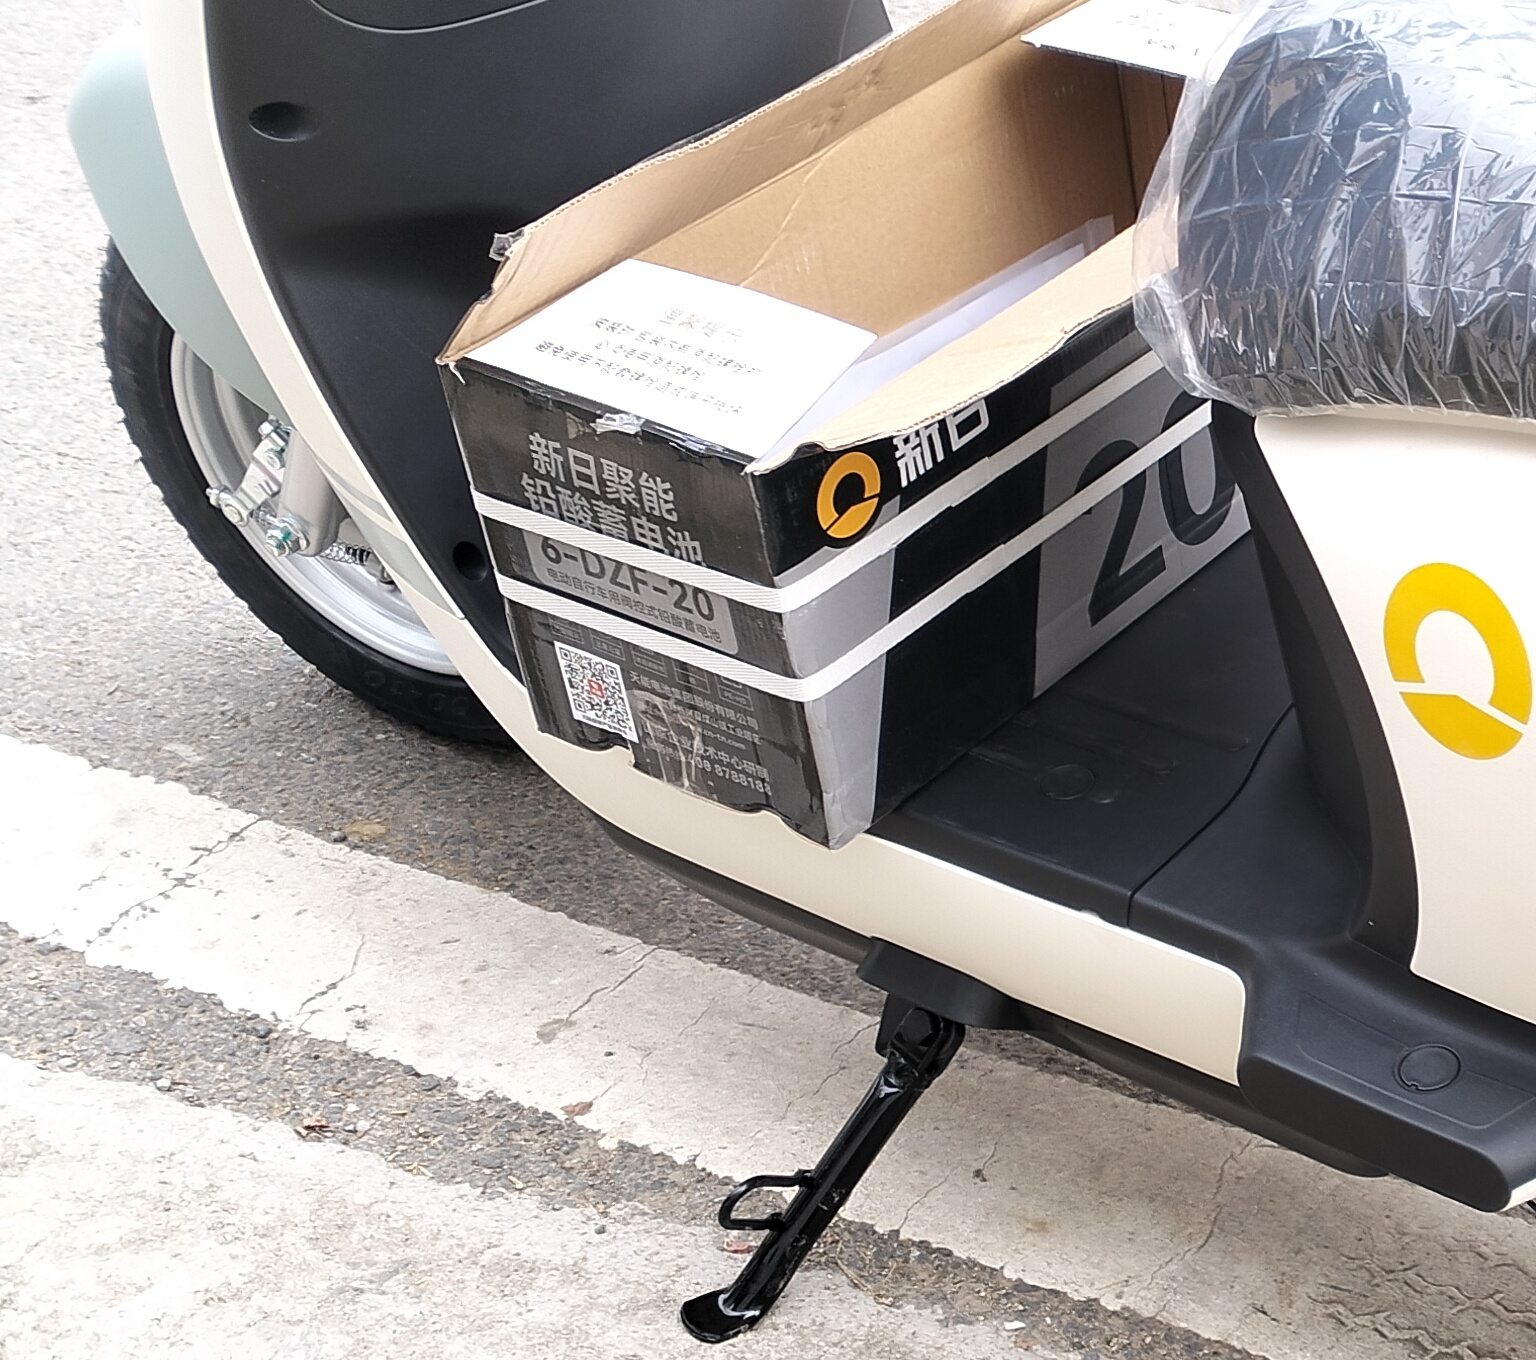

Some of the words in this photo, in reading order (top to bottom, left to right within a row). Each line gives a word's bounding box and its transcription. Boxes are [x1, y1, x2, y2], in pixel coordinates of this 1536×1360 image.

[520, 472, 707, 567] 铅酸蓄电池
[528, 431, 679, 523] 新日聚能
[1074, 389, 1238, 628] 20
[540, 536, 716, 622] 6-DZF-20
